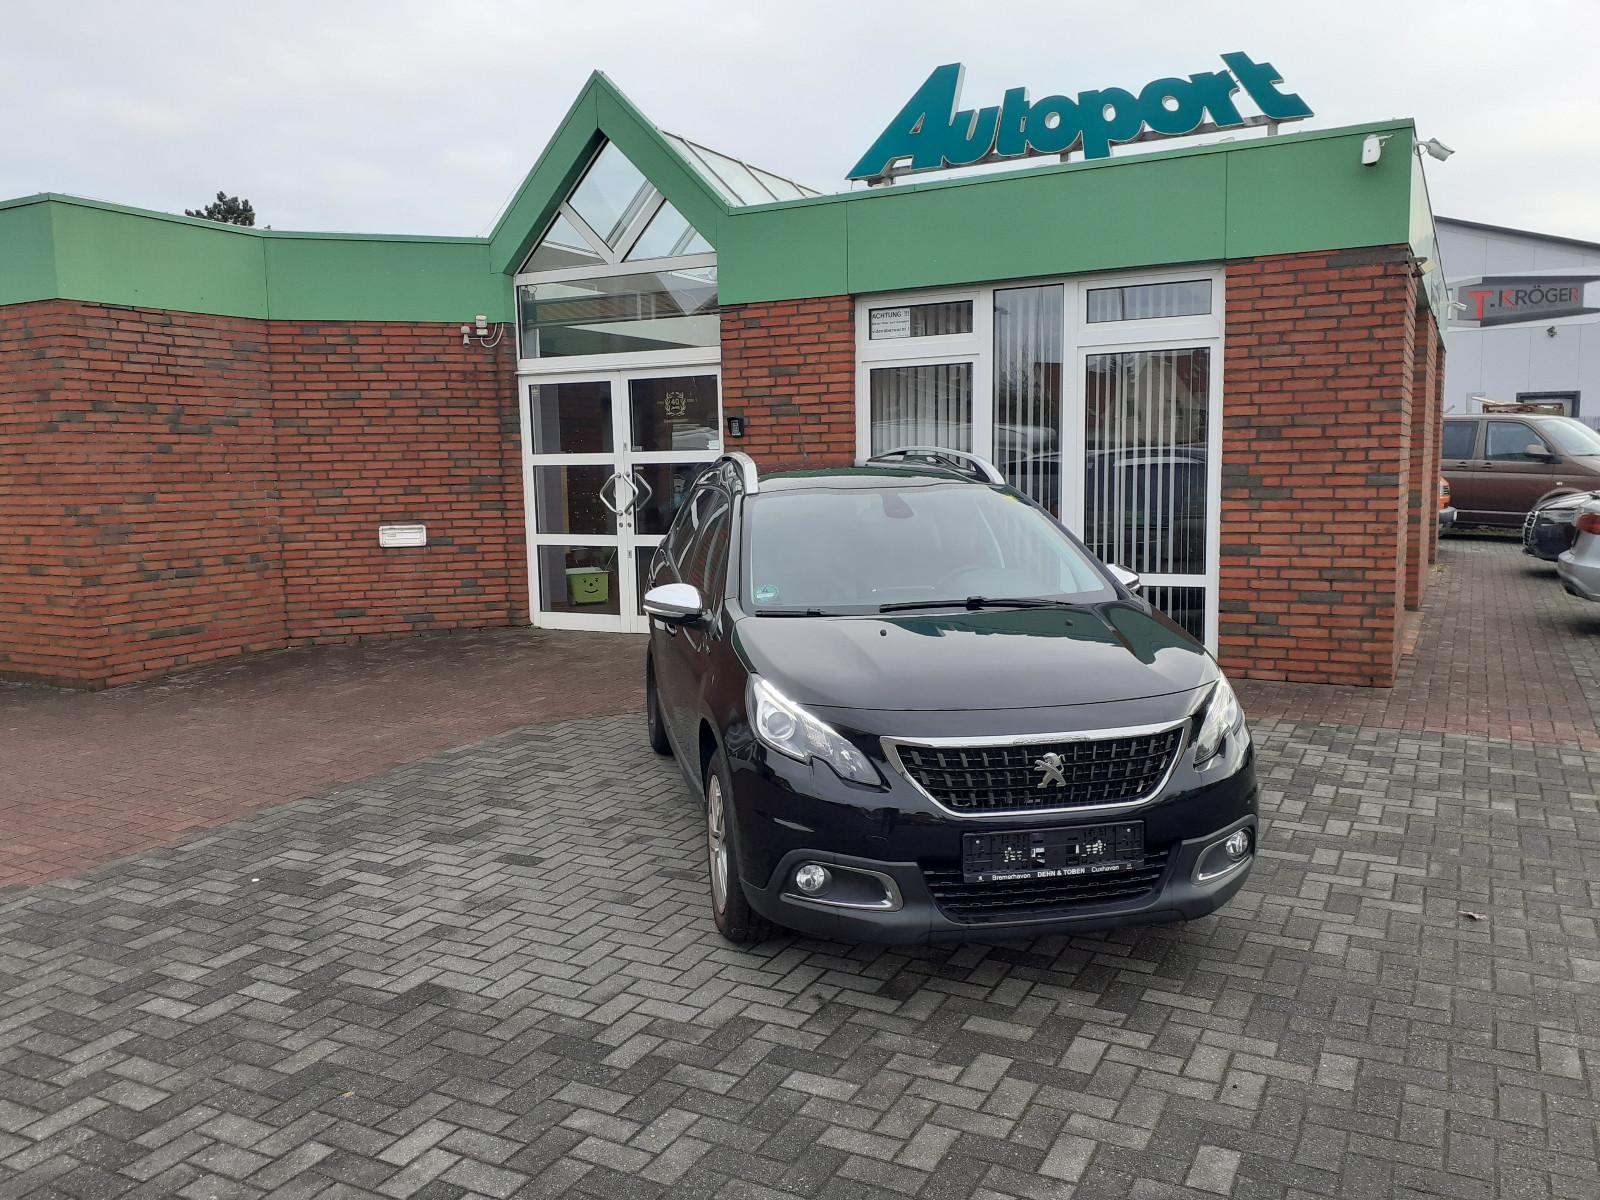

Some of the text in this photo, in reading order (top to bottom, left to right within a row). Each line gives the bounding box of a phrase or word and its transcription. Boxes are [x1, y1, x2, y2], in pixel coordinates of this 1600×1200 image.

[847, 51, 1314, 180] Autoport
[871, 311, 902, 319] ACHTUNG
[992, 872, 1031, 881] Bremerhaven
[1037, 870, 1056, 878] DEHN
[1063, 868, 1086, 876] TOBEN
[1091, 864, 1120, 873] Cuxhaven
